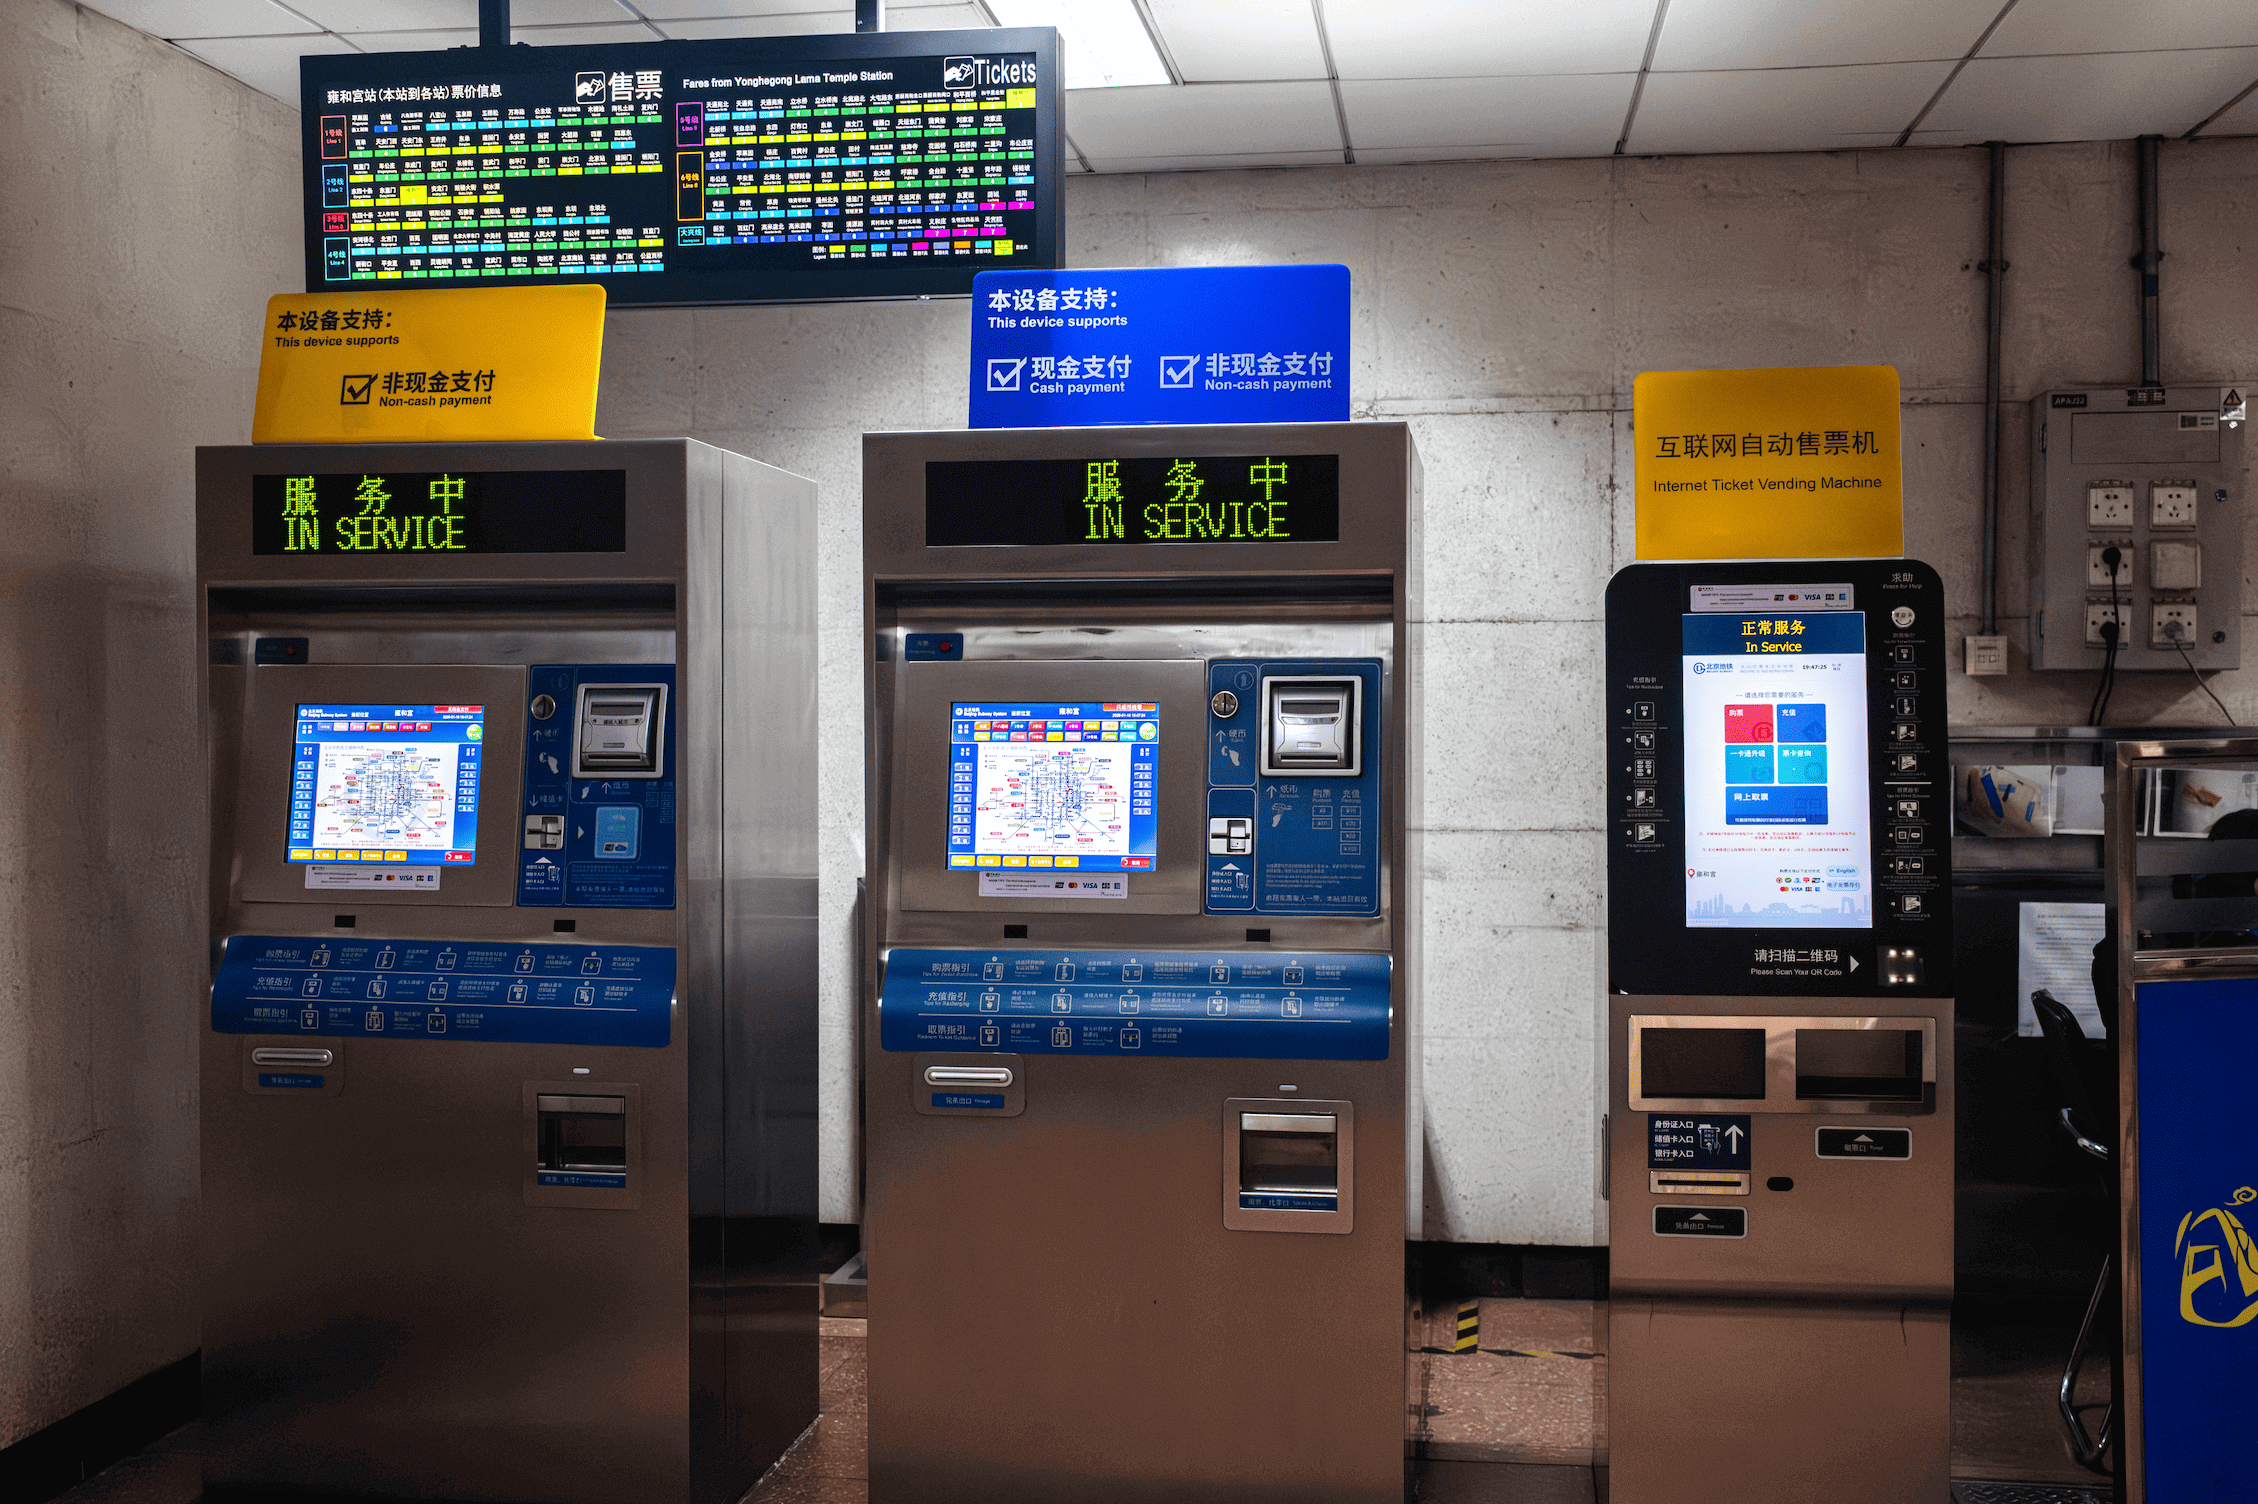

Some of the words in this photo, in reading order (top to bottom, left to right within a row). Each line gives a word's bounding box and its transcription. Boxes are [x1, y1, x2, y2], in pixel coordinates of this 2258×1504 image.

[975, 59, 1036, 84] Tickets
[608, 71, 663, 101] 售票
[683, 79, 709, 88] Fares
[711, 78, 732, 87] from
[734, 76, 792, 87] Yonghegong
[795, 74, 821, 84] Lama
[823, 73, 858, 83] Temple
[860, 71, 893, 80] Station
[327, 83, 502, 104] 雍和宫站(本站到各站)票价信息
[988, 317, 1017, 328] This
[1020, 316, 1063, 327] device
[1068, 315, 1127, 328] supports
[276, 336, 300, 347] This
[304, 336, 342, 346] device
[346, 335, 399, 346] supports
[1031, 354, 1131, 380] 现金支付
[1206, 352, 1333, 378] 非现金支付
[382, 370, 495, 394] 非现金支付
[1030, 382, 1063, 394] Cash
[1068, 382, 1125, 395] payment
[1205, 379, 1268, 391] Non-cash
[1273, 379, 1332, 392] payment
[380, 396, 435, 407] Non-cash
[440, 395, 491, 408] payment
[1656, 430, 1878, 458] 互联网自动售票机
[1654, 480, 1707, 492] Internet
[1712, 479, 1753, 491] Ticket
[1758, 478, 1815, 492] Vending
[1822, 477, 1882, 489] Machine
[1085, 503, 1124, 539] IN
[1144, 502, 1289, 538] SERVICE
[284, 517, 319, 550] IN
[336, 516, 466, 550] SERVICE
[1892, 572, 1913, 582] 求助
[1741, 620, 1805, 636] 正常服务
[1746, 642, 1758, 652] In
[1761, 642, 1802, 652] Service
[1754, 949, 1838, 962] 请扫描二维码
[932, 963, 969, 972] 购票指引
[257, 977, 292, 986] 充值指引
[929, 992, 966, 1001] 充值指引
[1655, 1121, 1693, 1129] 身份证入口
[1655, 1135, 1693, 1143] 储值卡入口
